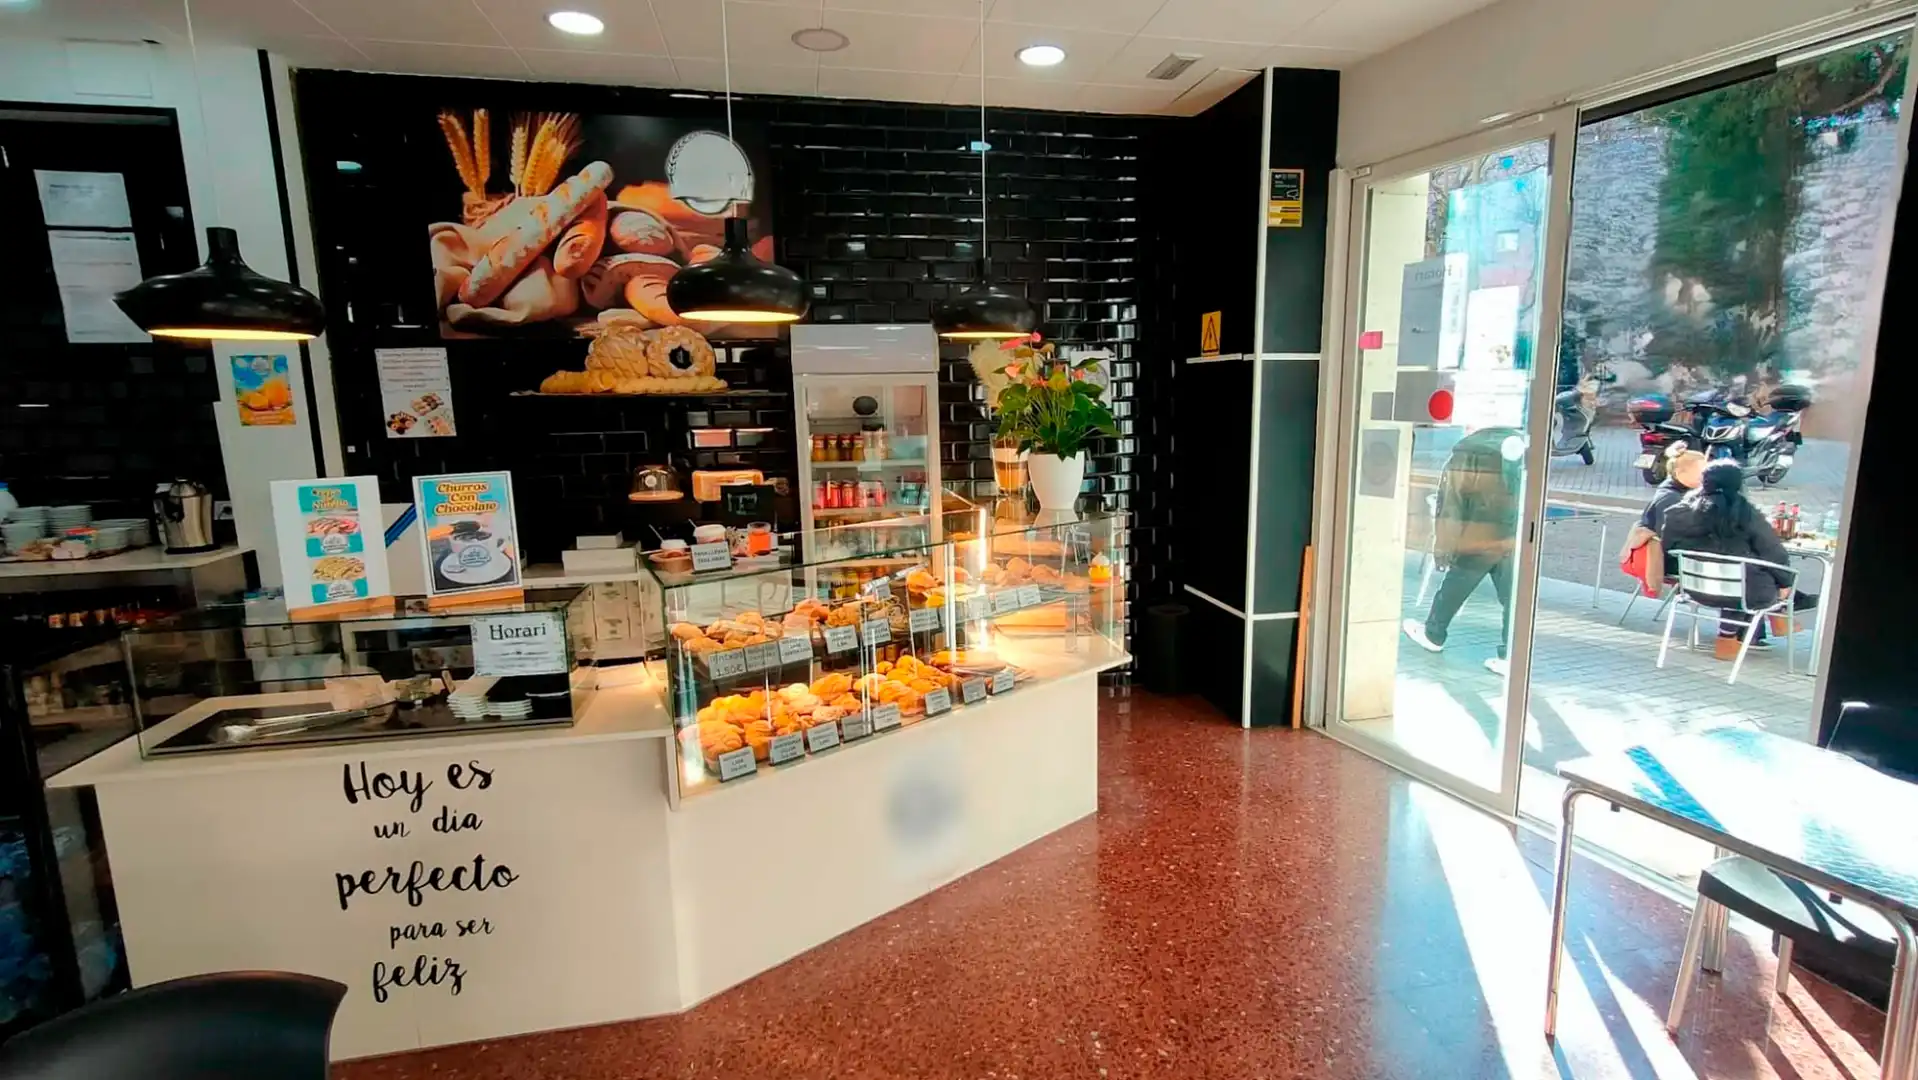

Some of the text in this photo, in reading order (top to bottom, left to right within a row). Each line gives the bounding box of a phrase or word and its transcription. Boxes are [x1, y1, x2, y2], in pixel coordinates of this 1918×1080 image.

[438, 483, 487, 493] Churros
[451, 493, 475, 501] Con
[436, 502, 497, 513] Chocolate
[489, 622, 546, 640] Horari
[343, 760, 495, 813] Hoy es
[374, 821, 411, 839] un
[335, 854, 520, 911] perfecto
[390, 918, 495, 950] para ser
[373, 955, 468, 1003] feliz
